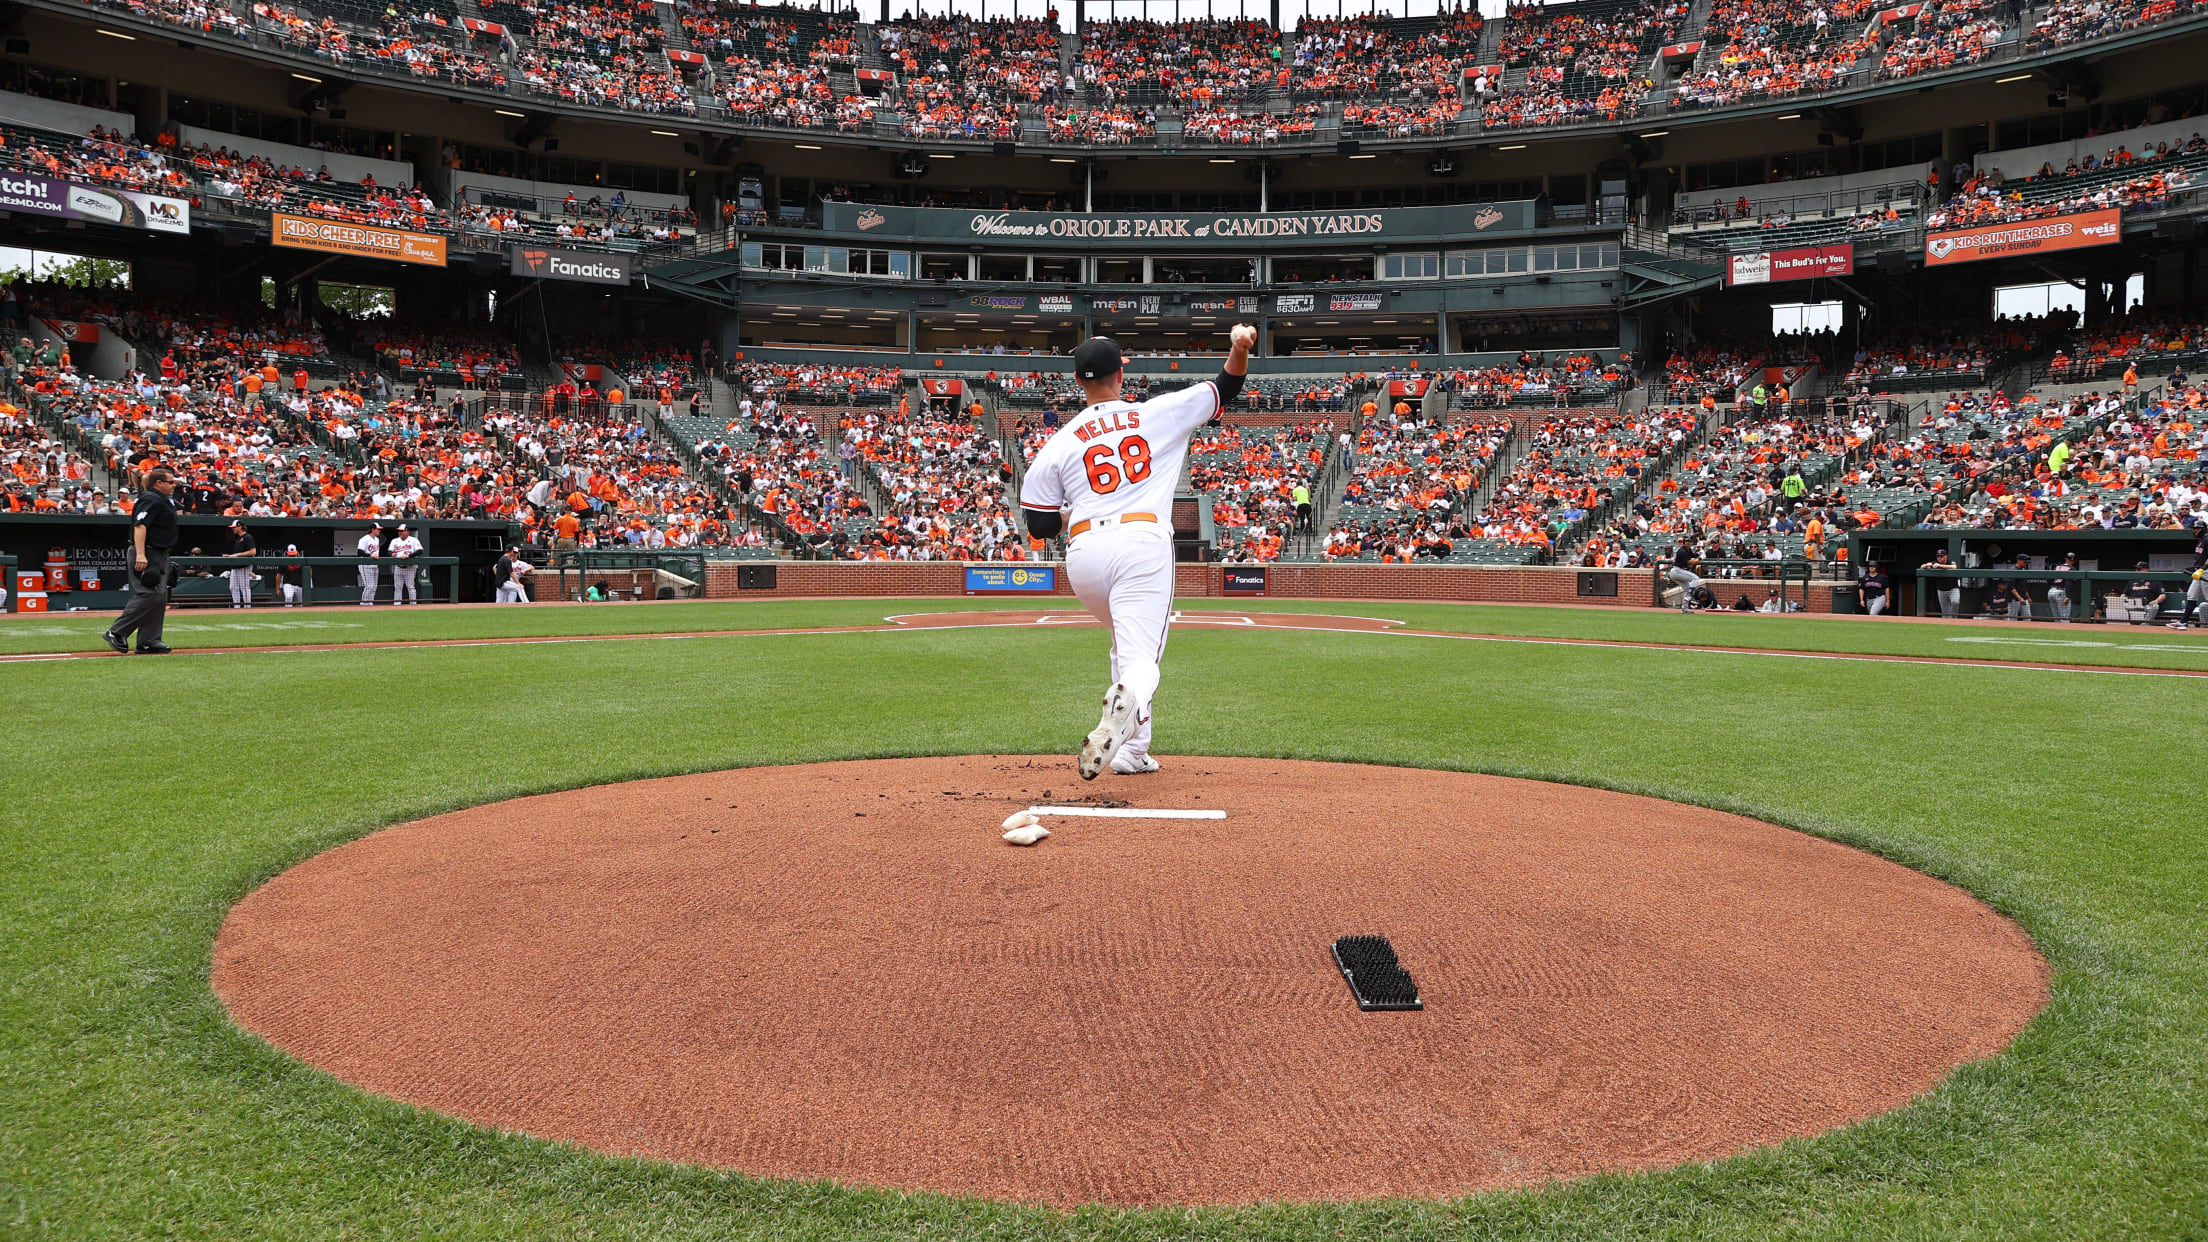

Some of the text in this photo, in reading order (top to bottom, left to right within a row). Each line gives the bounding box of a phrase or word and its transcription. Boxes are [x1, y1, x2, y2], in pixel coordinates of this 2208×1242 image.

[0, 177, 47, 198] tch!
[147, 216, 184, 226] DriveEzMD
[970, 213, 1383, 237] Welcome to ORIOLE PARK at CAMDEN YARDS
[282, 218, 401, 249] KIDS CHEER FREE
[2081, 222, 2117, 236] weis
[1953, 221, 2073, 249] KIDS RUN THE BASES
[1979, 239, 2042, 254] EVERY SUNDAY
[1774, 254, 1846, 269] This Bud's For You.
[550, 256, 621, 279] Fanatics
[1040, 295, 1071, 304] WBAL
[1093, 300, 1137, 309] masn
[1142, 296, 1160, 304] EVERY
[1277, 295, 1314, 305] ESPN
[1142, 303, 1160, 314] PLAY.
[1240, 304, 1260, 313] GAME.
[1330, 301, 1353, 310] 93.9
[1073, 411, 1140, 443] WELLS
[1082, 434, 1152, 495] 68
[202, 490, 209, 502] 2
[53, 569, 63, 579] G
[421, 568, 427, 578] 4
[22, 578, 33, 588] G
[87, 580, 96, 589] G
[1235, 576, 1264, 584] Fanatics
[26, 598, 37, 608] G
